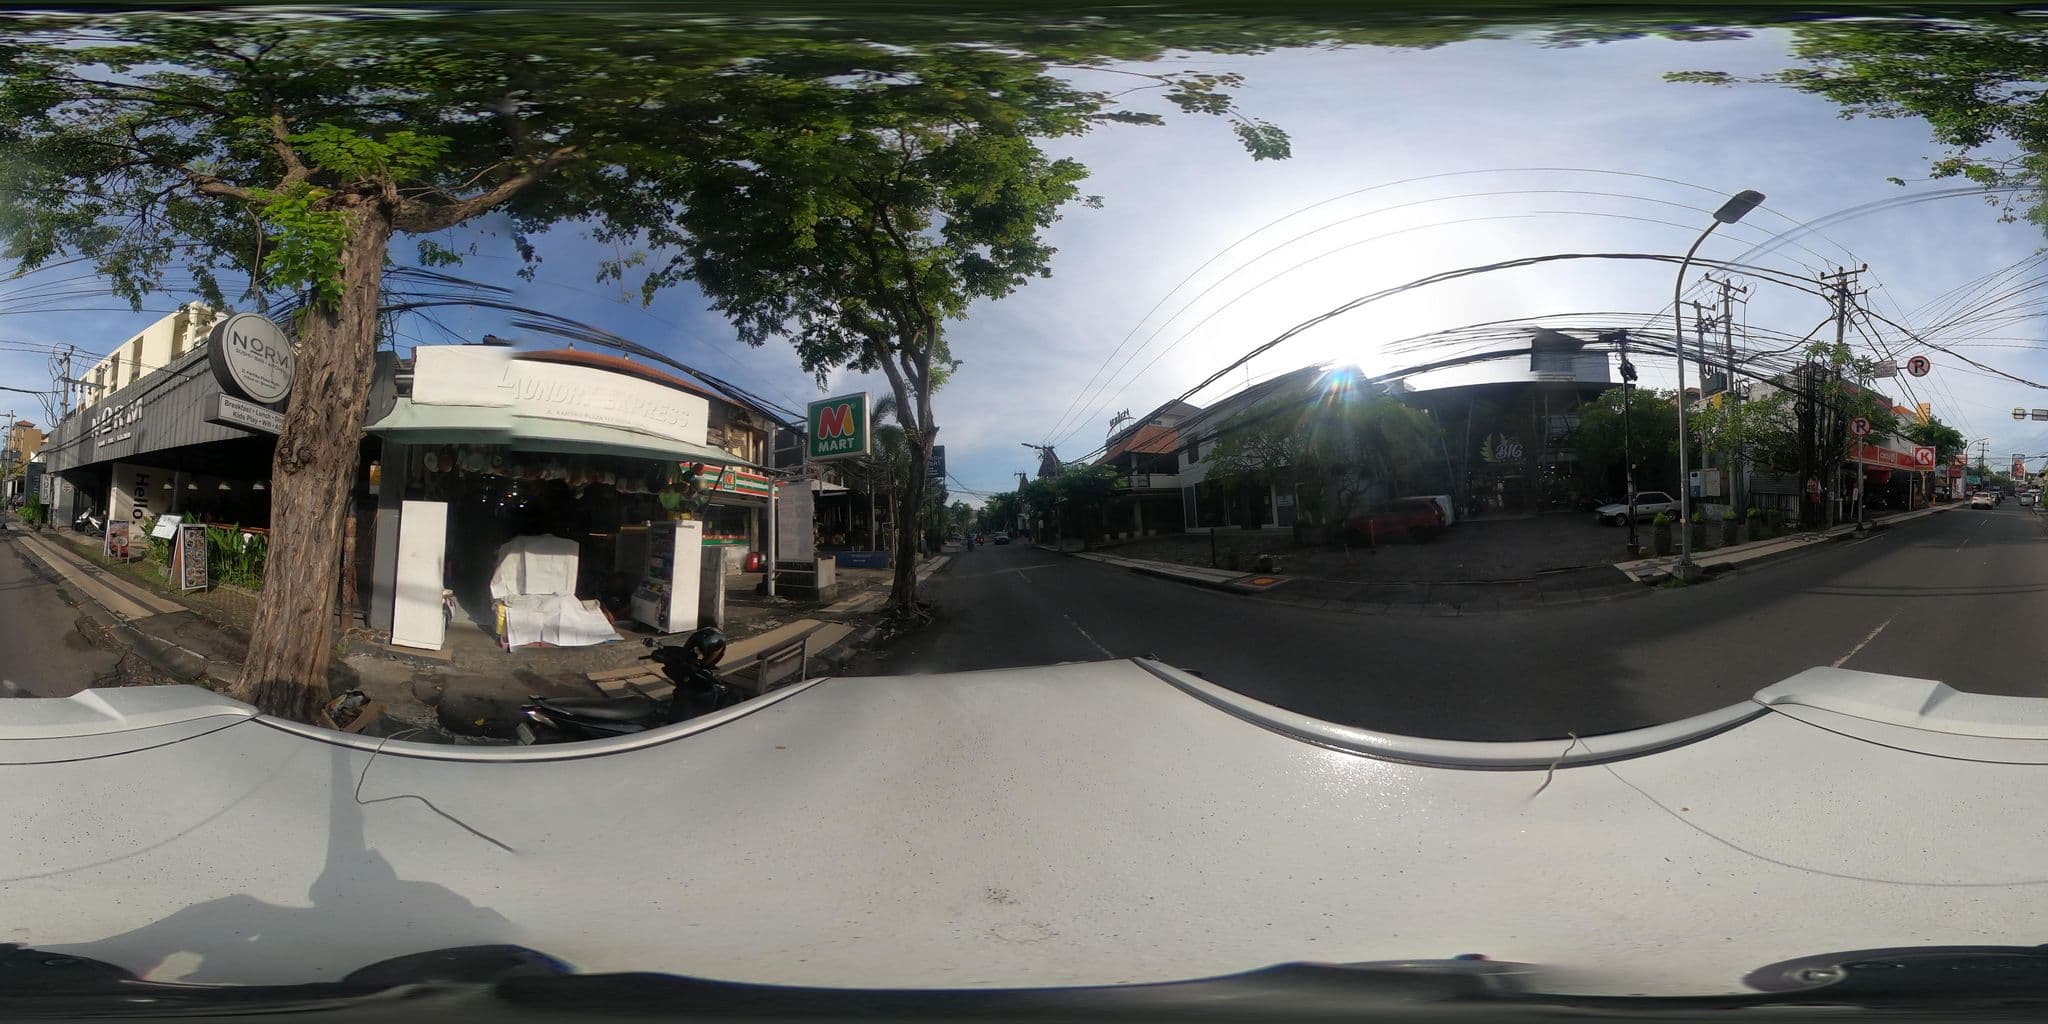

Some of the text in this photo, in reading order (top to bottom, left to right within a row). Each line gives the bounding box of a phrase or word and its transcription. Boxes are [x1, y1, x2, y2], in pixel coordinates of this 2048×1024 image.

[232, 330, 289, 369] NORM
[91, 397, 144, 438] NORM
[818, 437, 855, 452] MART
[1495, 443, 1523, 460] BIG
[132, 473, 150, 525] Hello.
